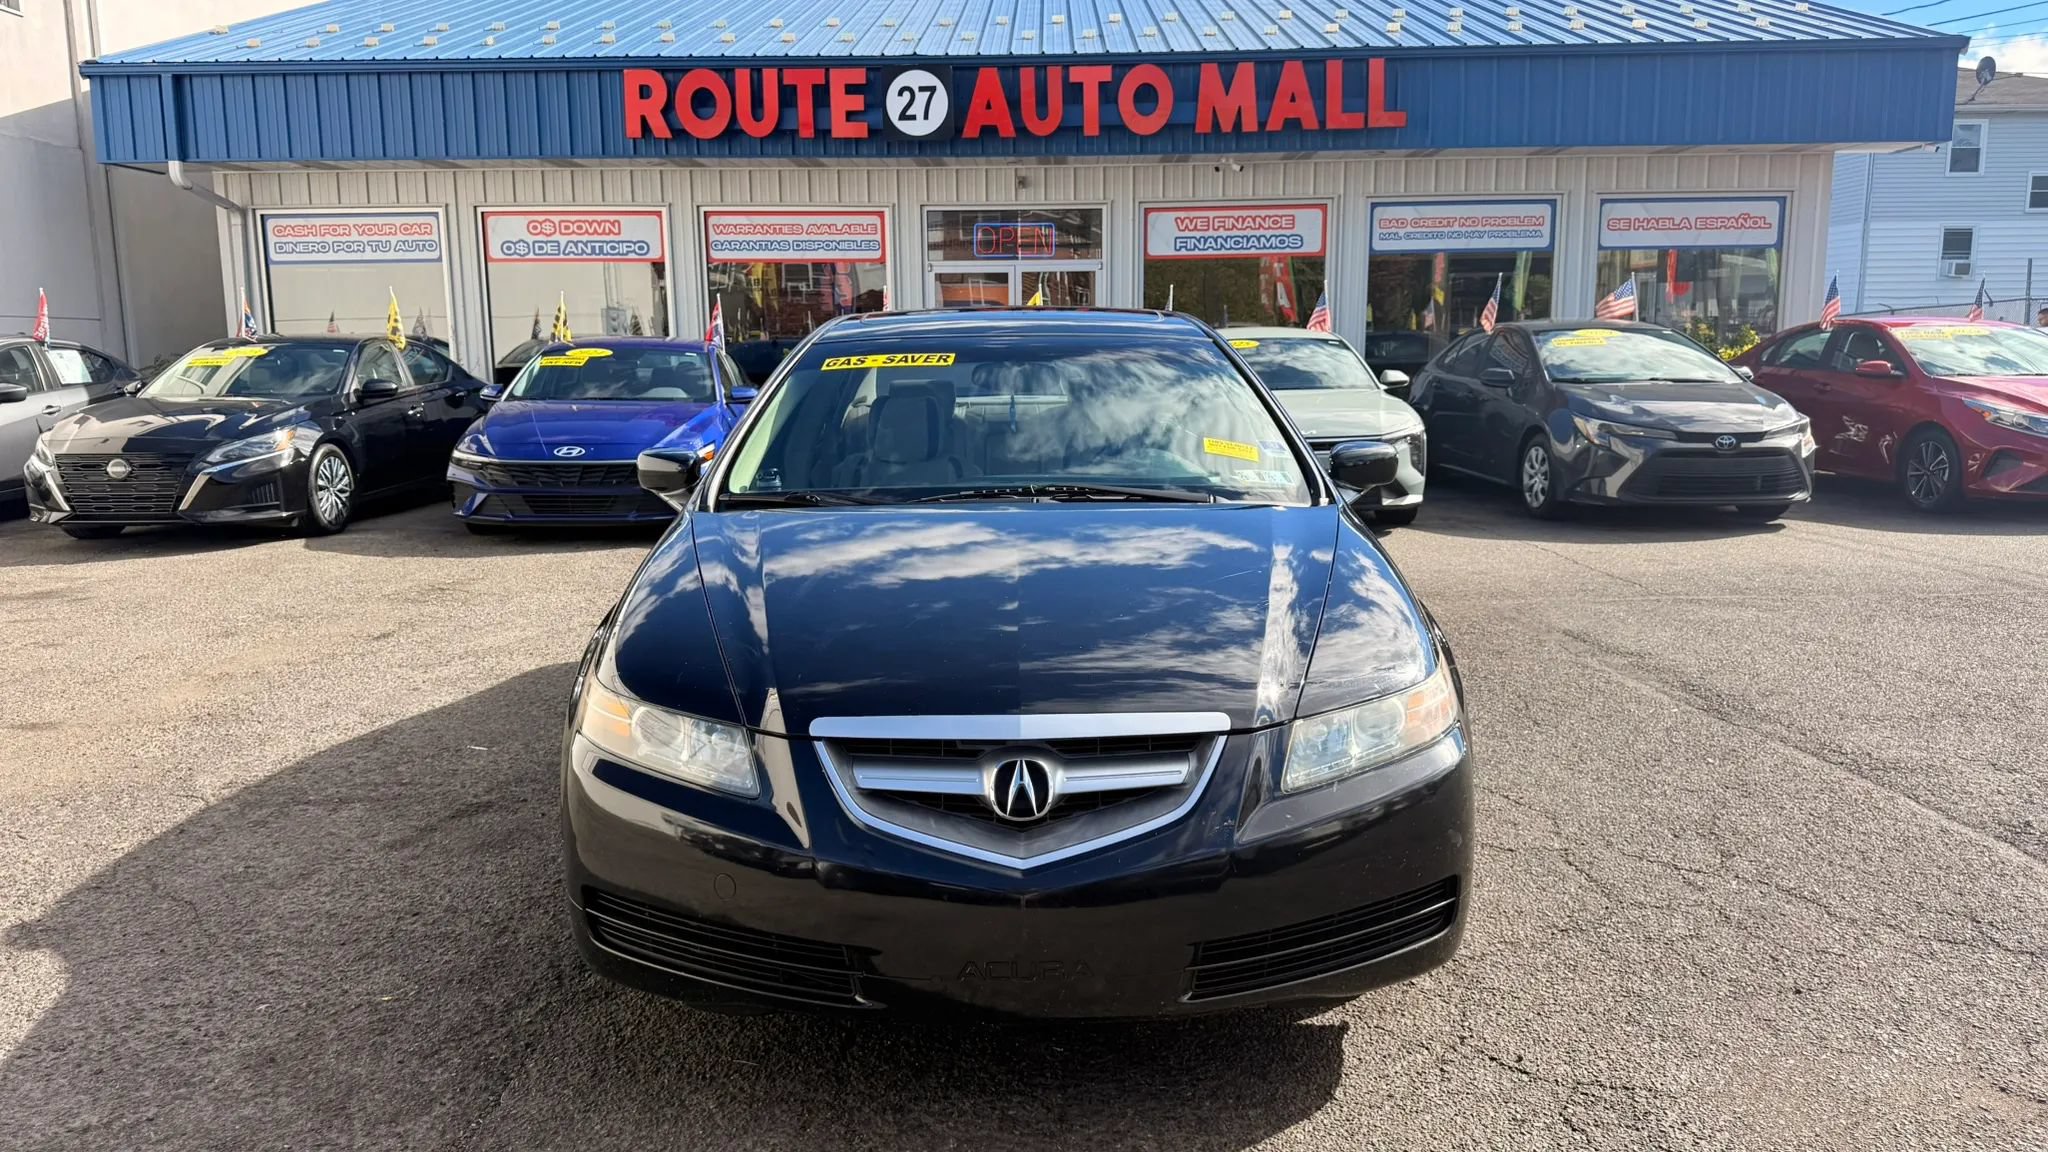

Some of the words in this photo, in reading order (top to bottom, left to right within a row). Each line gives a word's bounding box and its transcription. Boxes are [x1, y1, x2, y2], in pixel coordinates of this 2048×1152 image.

[623, 67, 871, 140] ROUTE
[897, 85, 937, 122] 27
[961, 63, 1174, 139] AUTO
[1195, 57, 1407, 133] MALL
[560, 220, 621, 235] DOWN
[1175, 216, 1209, 231] WE
[1212, 215, 1295, 230] FINANCE
[1379, 218, 1408, 229] BAD
[1410, 217, 1456, 228] CREDIT
[1458, 217, 1479, 228] NO
[1481, 216, 1544, 227] PROBLEM
[1607, 218, 1631, 231] SE
[1633, 217, 1691, 230] HABLA
[1695, 212, 1772, 230] ESPAÑOL
[273, 224, 316, 237] CASH
[319, 224, 351, 236] FOR
[353, 223, 397, 236] YOUR
[400, 222, 432, 235] CAR
[712, 224, 803, 235] WARRANTIES
[805, 224, 877, 235] AVAILABLE
[1379, 232, 1402, 241] MAL
[1403, 231, 1446, 240] CREDITO
[1447, 231, 1463, 239] NO
[1464, 231, 1486, 239] HAY
[1487, 229, 1543, 239] PROBLEMA
[275, 241, 330, 254] DINERO
[332, 240, 364, 253] POR
[367, 240, 390, 253] TU
[394, 240, 437, 252] AUTO
[533, 240, 560, 256] DE
[562, 240, 649, 256] ANTICIPO
[711, 240, 790, 251] GARANTIAS
[790, 240, 880, 251] DISPONIBLES
[977, 227, 1054, 254] OPEN
[1175, 234, 1303, 251] FINANCIAMOS
[825, 357, 867, 368] GAS
[882, 354, 952, 365] SAVER
[957, 960, 1095, 981] ACURA
